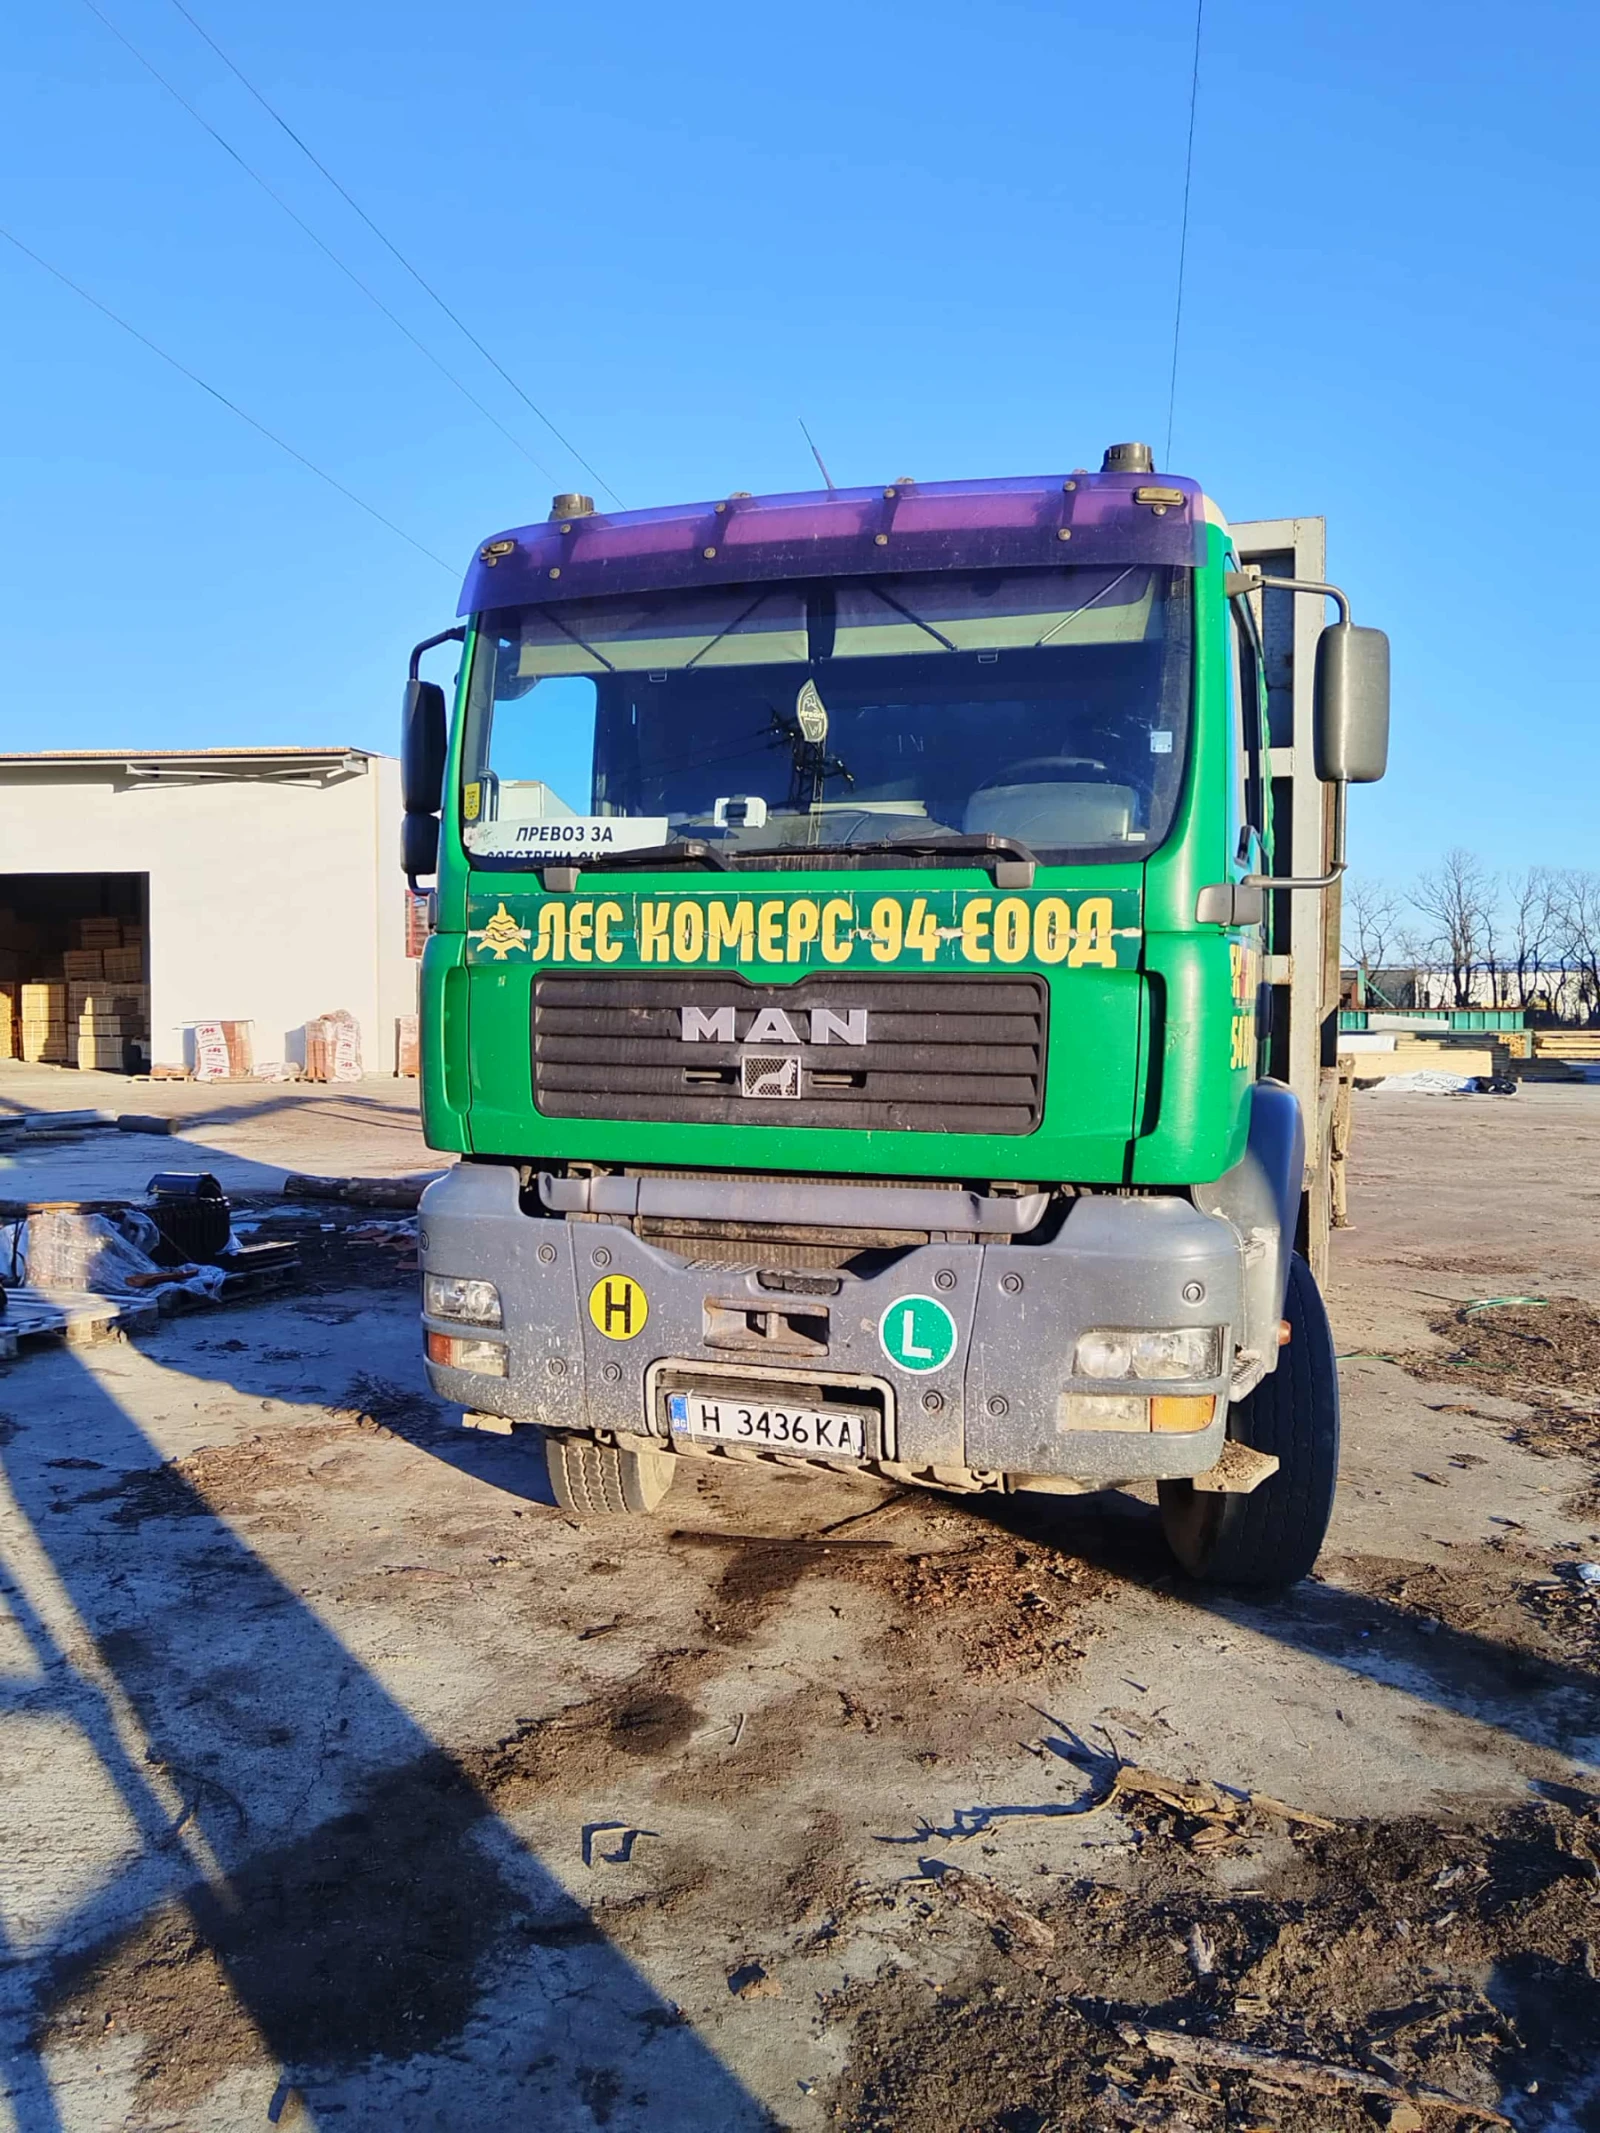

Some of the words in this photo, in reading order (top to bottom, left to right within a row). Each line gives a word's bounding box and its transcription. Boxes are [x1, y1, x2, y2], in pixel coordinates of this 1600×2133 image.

[516, 826, 584, 842] ПРЕВОЗ
[591, 826, 613, 842] ЗА
[533, 900, 623, 963] ЛЕС
[641, 898, 853, 963] КОМЕРС
[871, 897, 938, 962] 94
[962, 897, 1117, 968] ЕООД
[682, 1006, 868, 1046] MAN
[605, 1282, 632, 1334] H
[902, 1310, 932, 1360] L
